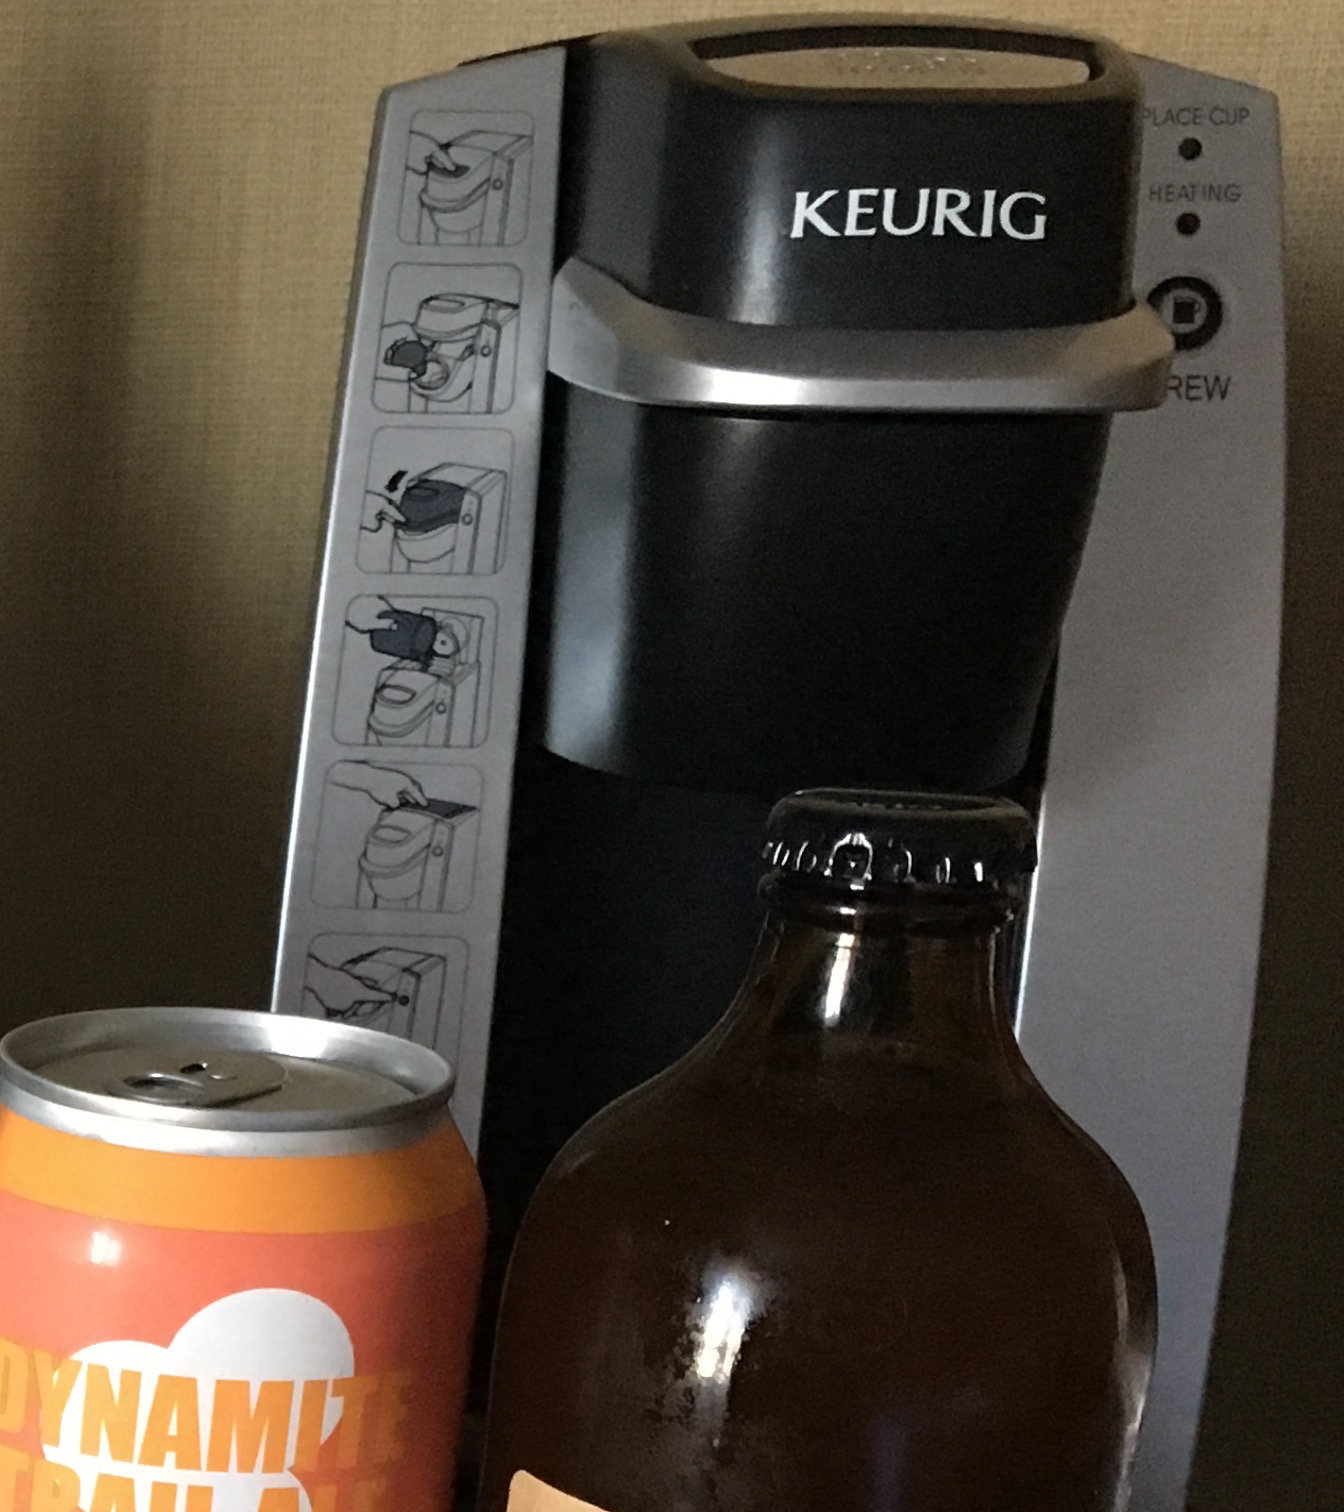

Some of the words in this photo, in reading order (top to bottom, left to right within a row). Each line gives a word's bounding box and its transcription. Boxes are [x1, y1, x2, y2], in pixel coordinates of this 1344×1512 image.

[1143, 107, 1201, 127] PLACE
[1208, 107, 1250, 126] CUP
[1148, 184, 1243, 202] HEATING
[790, 188, 1047, 240] KEURIG
[1167, 374, 1232, 401] REW
